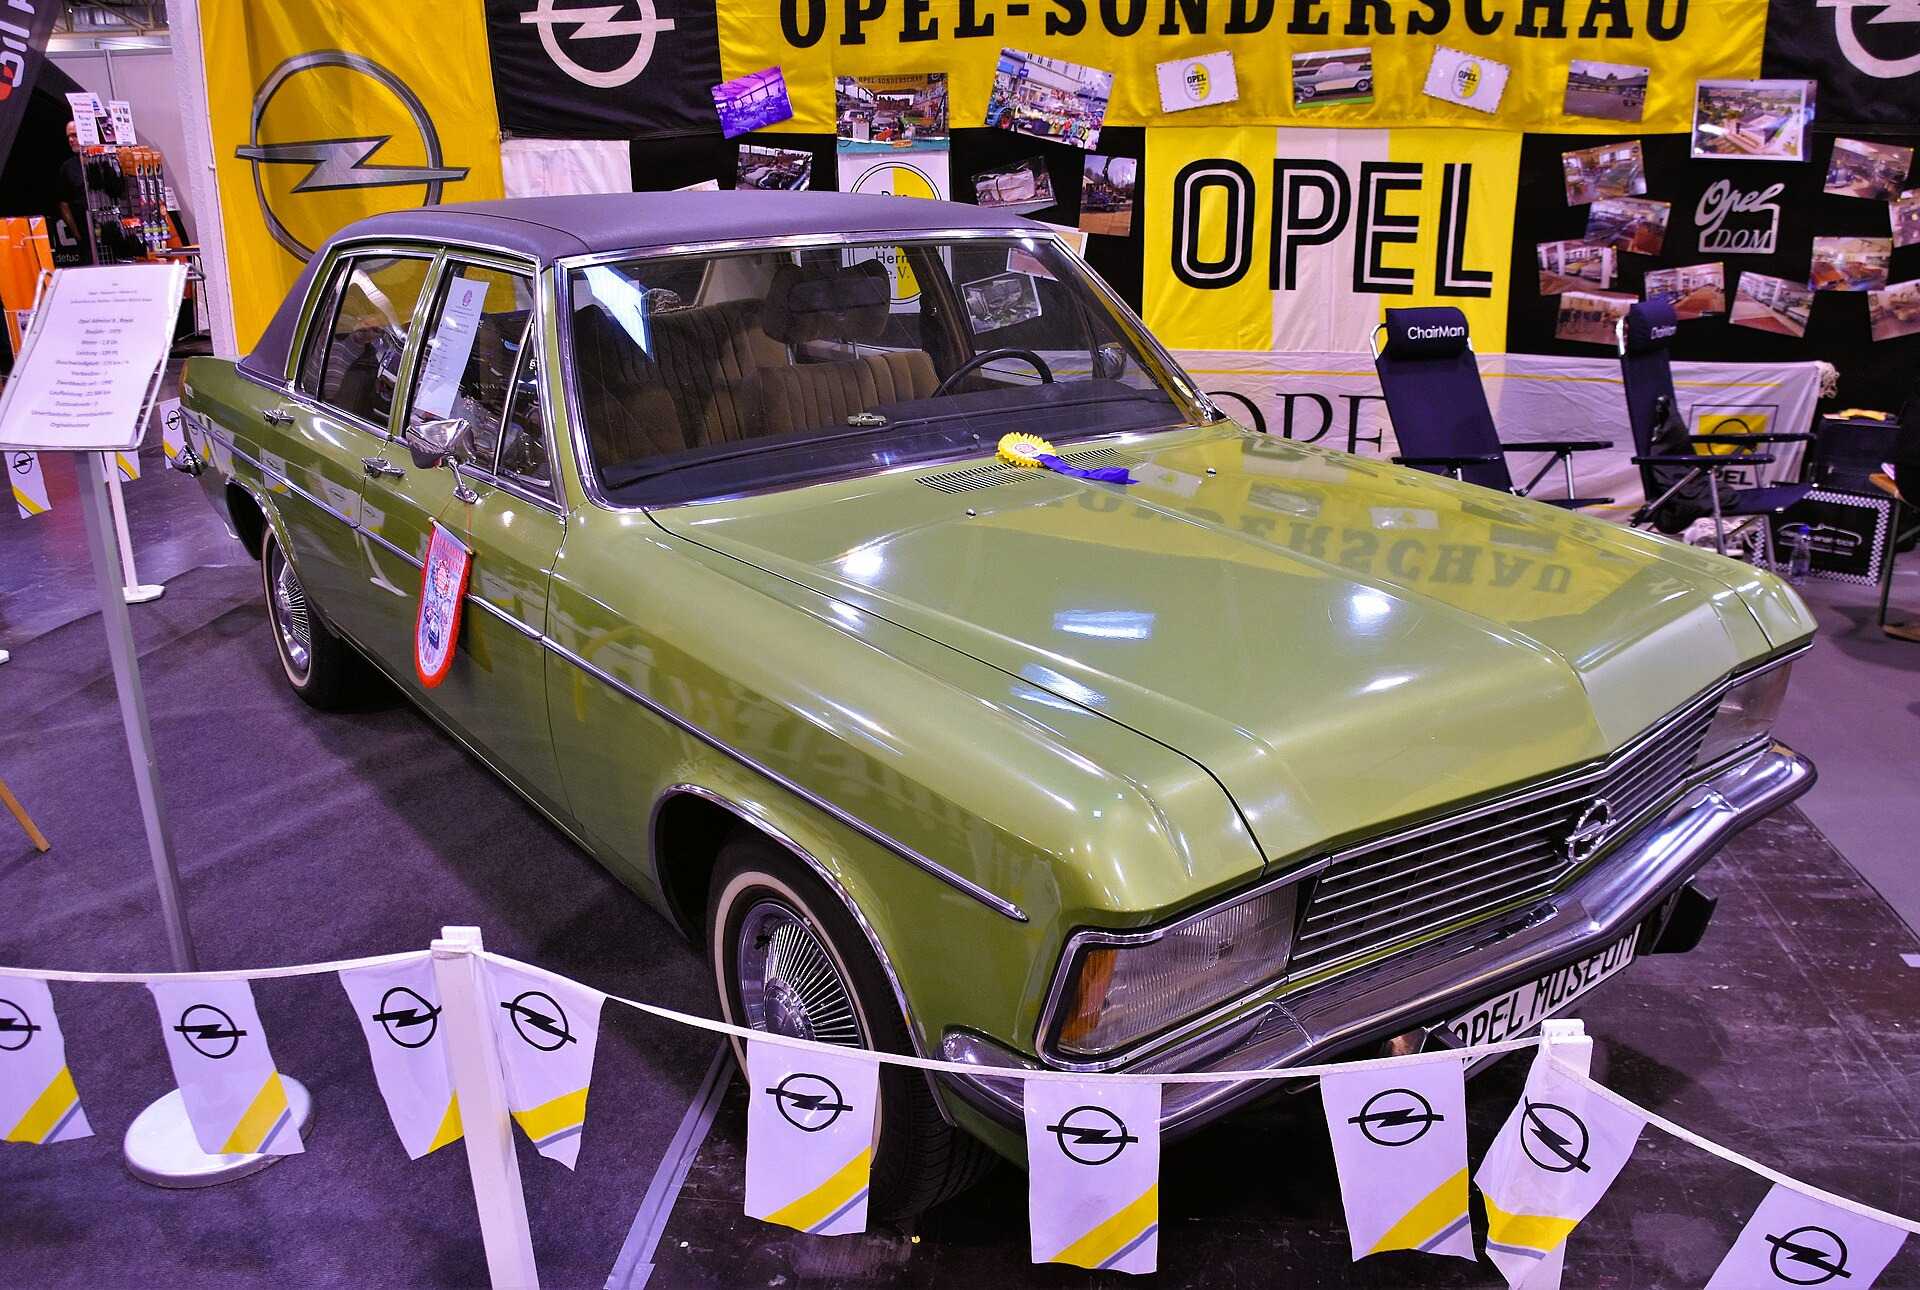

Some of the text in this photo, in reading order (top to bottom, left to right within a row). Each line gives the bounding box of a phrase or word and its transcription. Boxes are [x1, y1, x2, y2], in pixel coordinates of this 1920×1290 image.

[1187, 74, 1206, 84] OPEL
[1457, 70, 1477, 82] OPEL
[1694, 178, 1785, 226] Opel
[1171, 158, 1493, 298] OPEL
[1714, 229, 1773, 249] DOM
[876, 251, 909, 264] Hern
[1407, 325, 1465, 340] ChairMan
[1529, 925, 1639, 1022] MUSEUM
